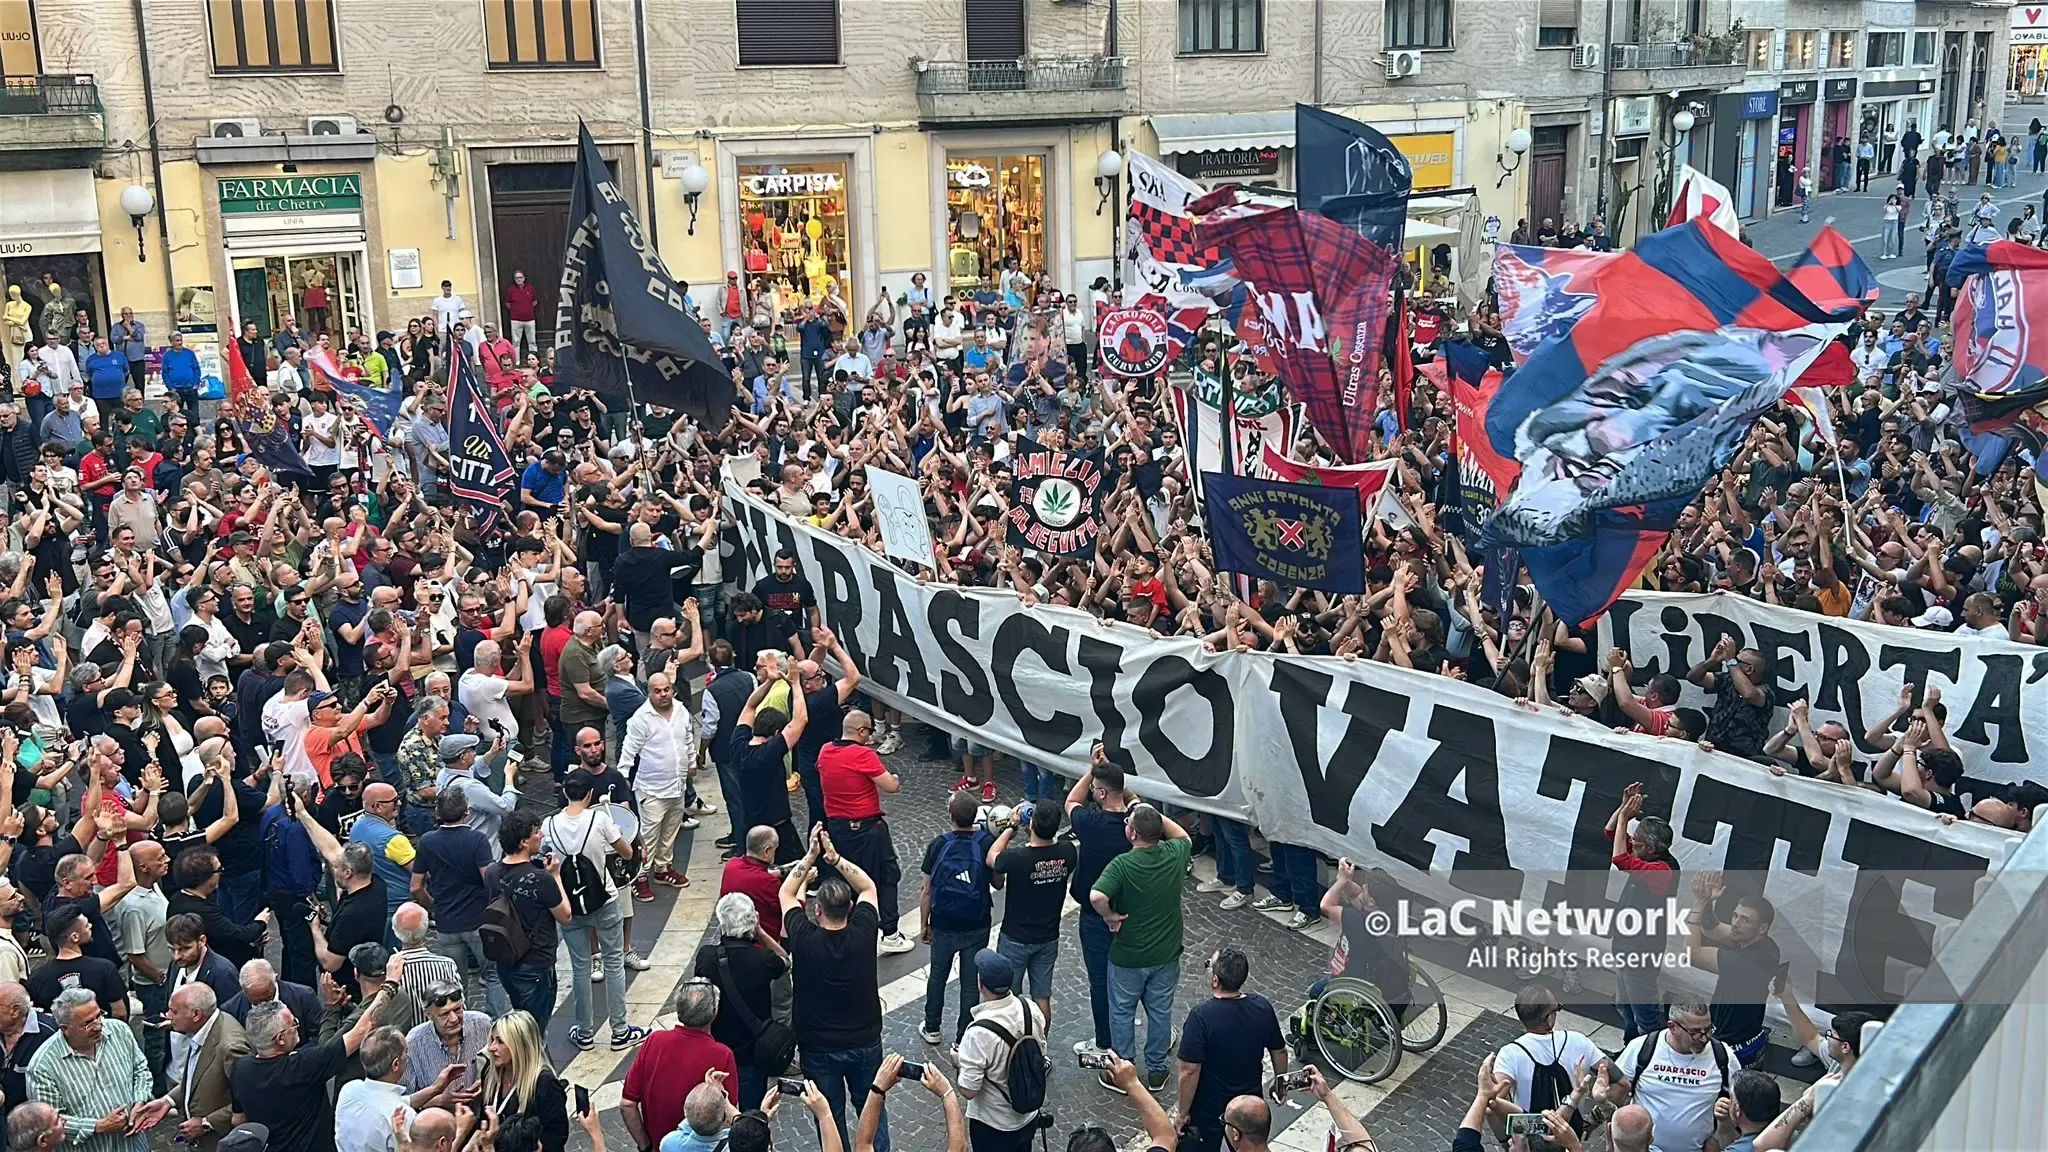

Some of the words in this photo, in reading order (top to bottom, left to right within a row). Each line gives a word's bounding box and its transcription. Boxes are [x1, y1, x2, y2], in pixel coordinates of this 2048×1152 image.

[1200, 152, 1260, 165] TRATTORIA
[750, 171, 839, 195] CARPISA
[1230, 168, 1261, 176] COSENTINE
[221, 176, 359, 199] FARMACIA
[256, 200, 274, 212] dr.
[1349, 321, 1367, 363] Cosenza
[1107, 353, 1142, 372] CURVA
[1144, 350, 1164, 369] SUD
[1342, 365, 1361, 407] Ultras
[1025, 515, 1099, 554] SEGUITO
[1255, 551, 1327, 581] COSENZA
[1653, 1064, 1707, 1077] GUARASCIO
[1657, 1074, 1701, 1086] VATTENE
